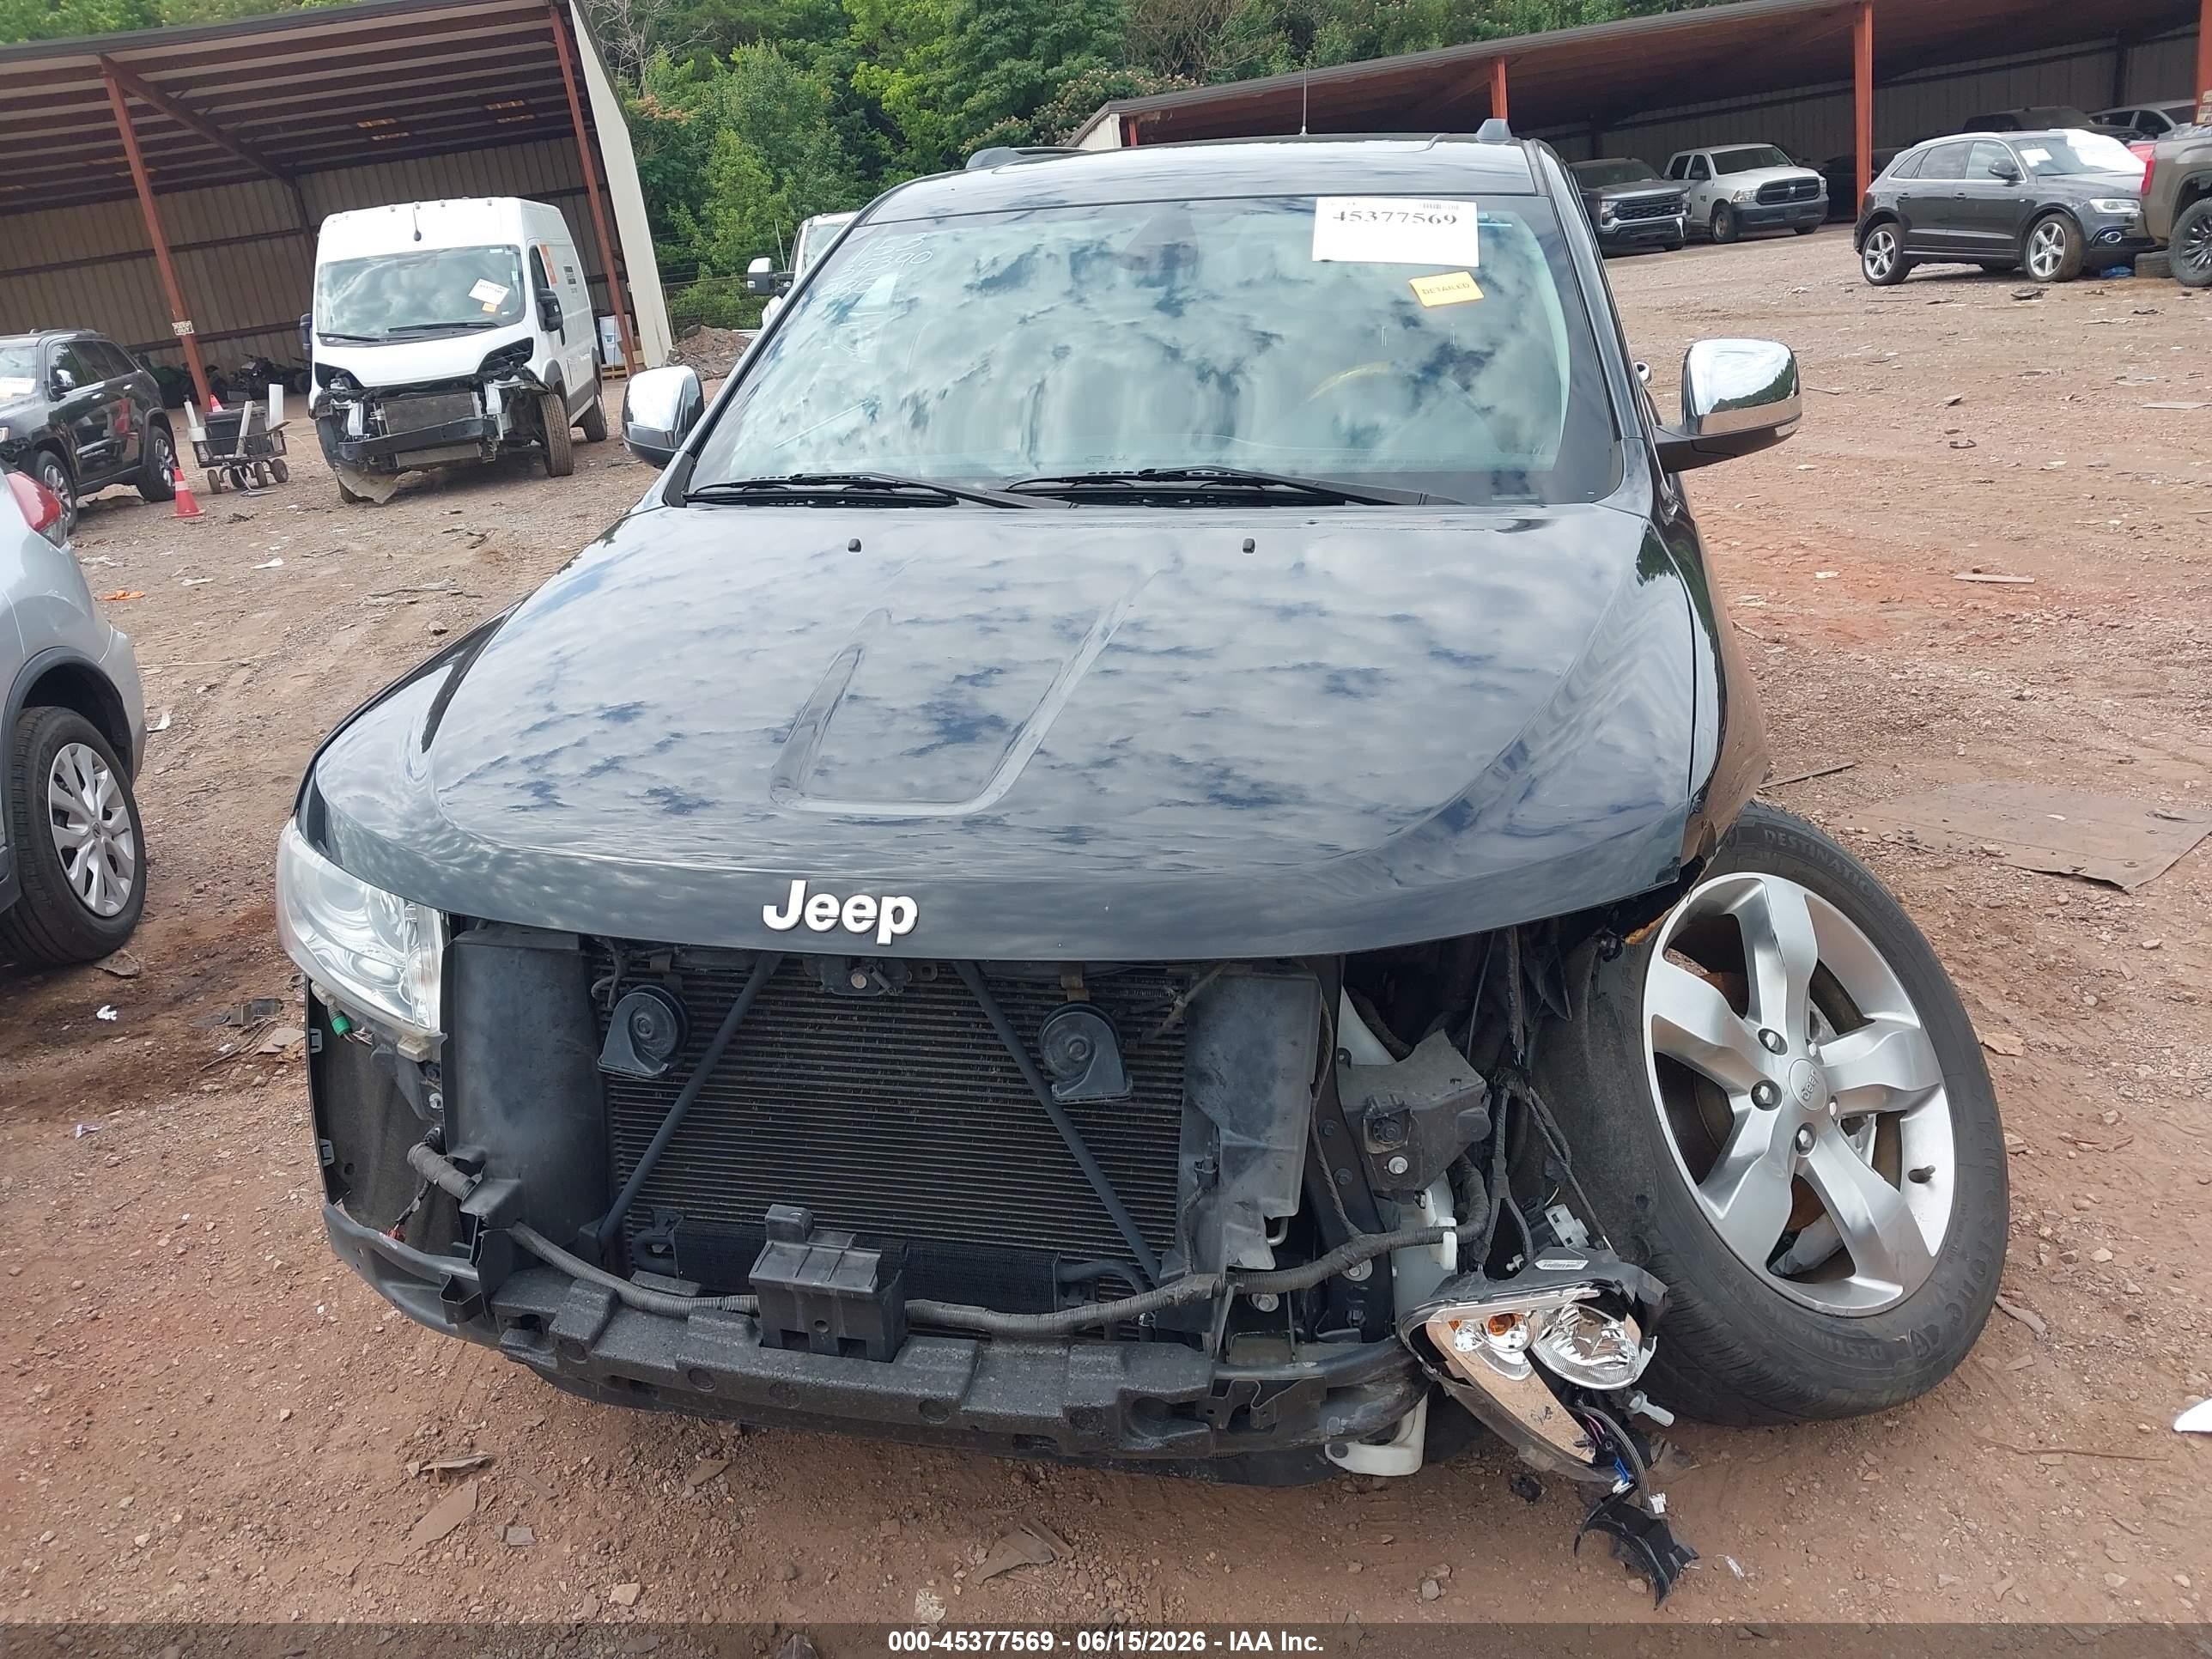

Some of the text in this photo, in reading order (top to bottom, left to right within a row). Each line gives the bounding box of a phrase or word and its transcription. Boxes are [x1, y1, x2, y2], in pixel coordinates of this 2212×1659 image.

[1333, 210, 1457, 225] 45377569
[1421, 282, 1470, 295] DETAILED
[763, 879, 919, 945] Jeep
[1801, 1068, 1820, 1102] Jeep
